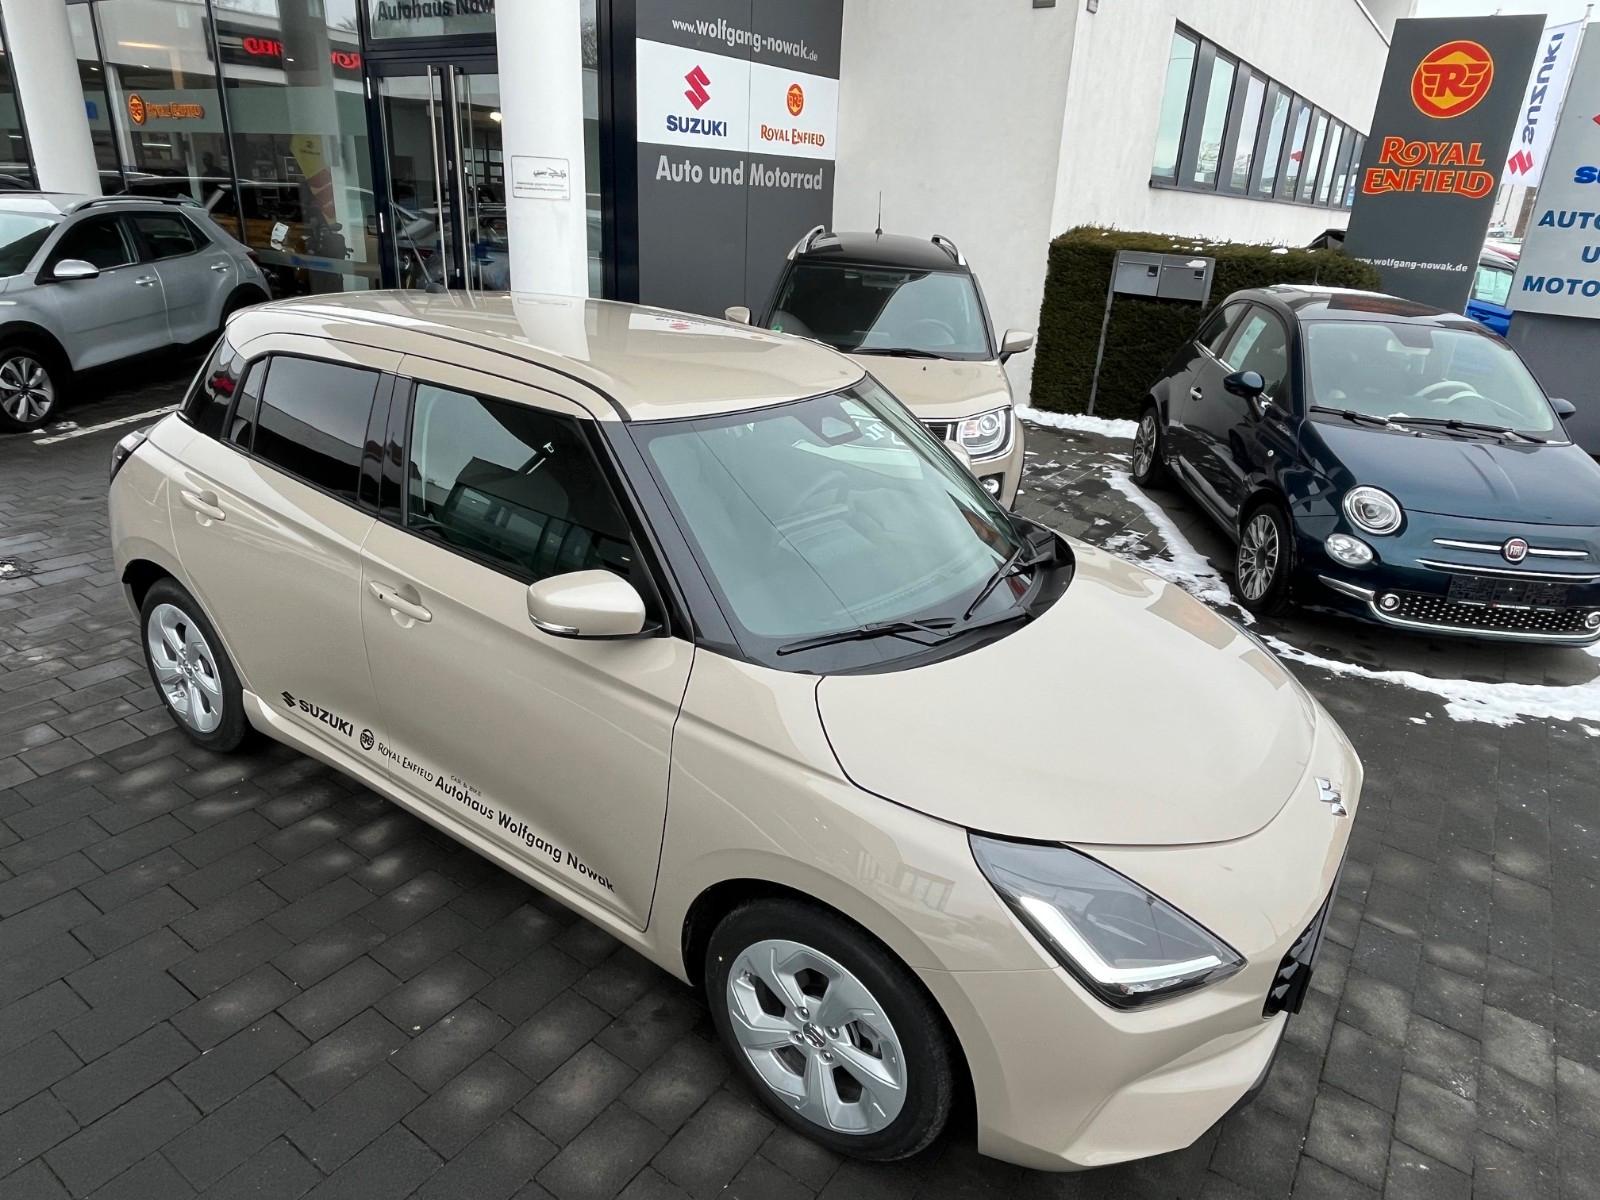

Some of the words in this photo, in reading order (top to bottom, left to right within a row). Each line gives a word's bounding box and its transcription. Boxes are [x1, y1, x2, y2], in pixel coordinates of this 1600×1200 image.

[666, 115, 727, 137] SUZUKI
[761, 125, 790, 142] ROYAL
[791, 128, 825, 147] ENFIELD
[1379, 137, 1485, 168] ROYAL
[656, 155, 703, 183] Auto
[709, 161, 744, 185] und
[749, 163, 823, 190] Motorrad
[1362, 169, 1494, 199] ENFIELD
[1574, 166, 1600, 184] S
[1509, 545, 1524, 556] FIAT
[299, 698, 354, 737] SUZUKI
[378, 742, 400, 764] ROYAL
[402, 757, 433, 781] ENFIELD
[435, 776, 494, 820] Autohaus
[498, 810, 562, 863] Wolfgang
[567, 856, 615, 892] Nowak
